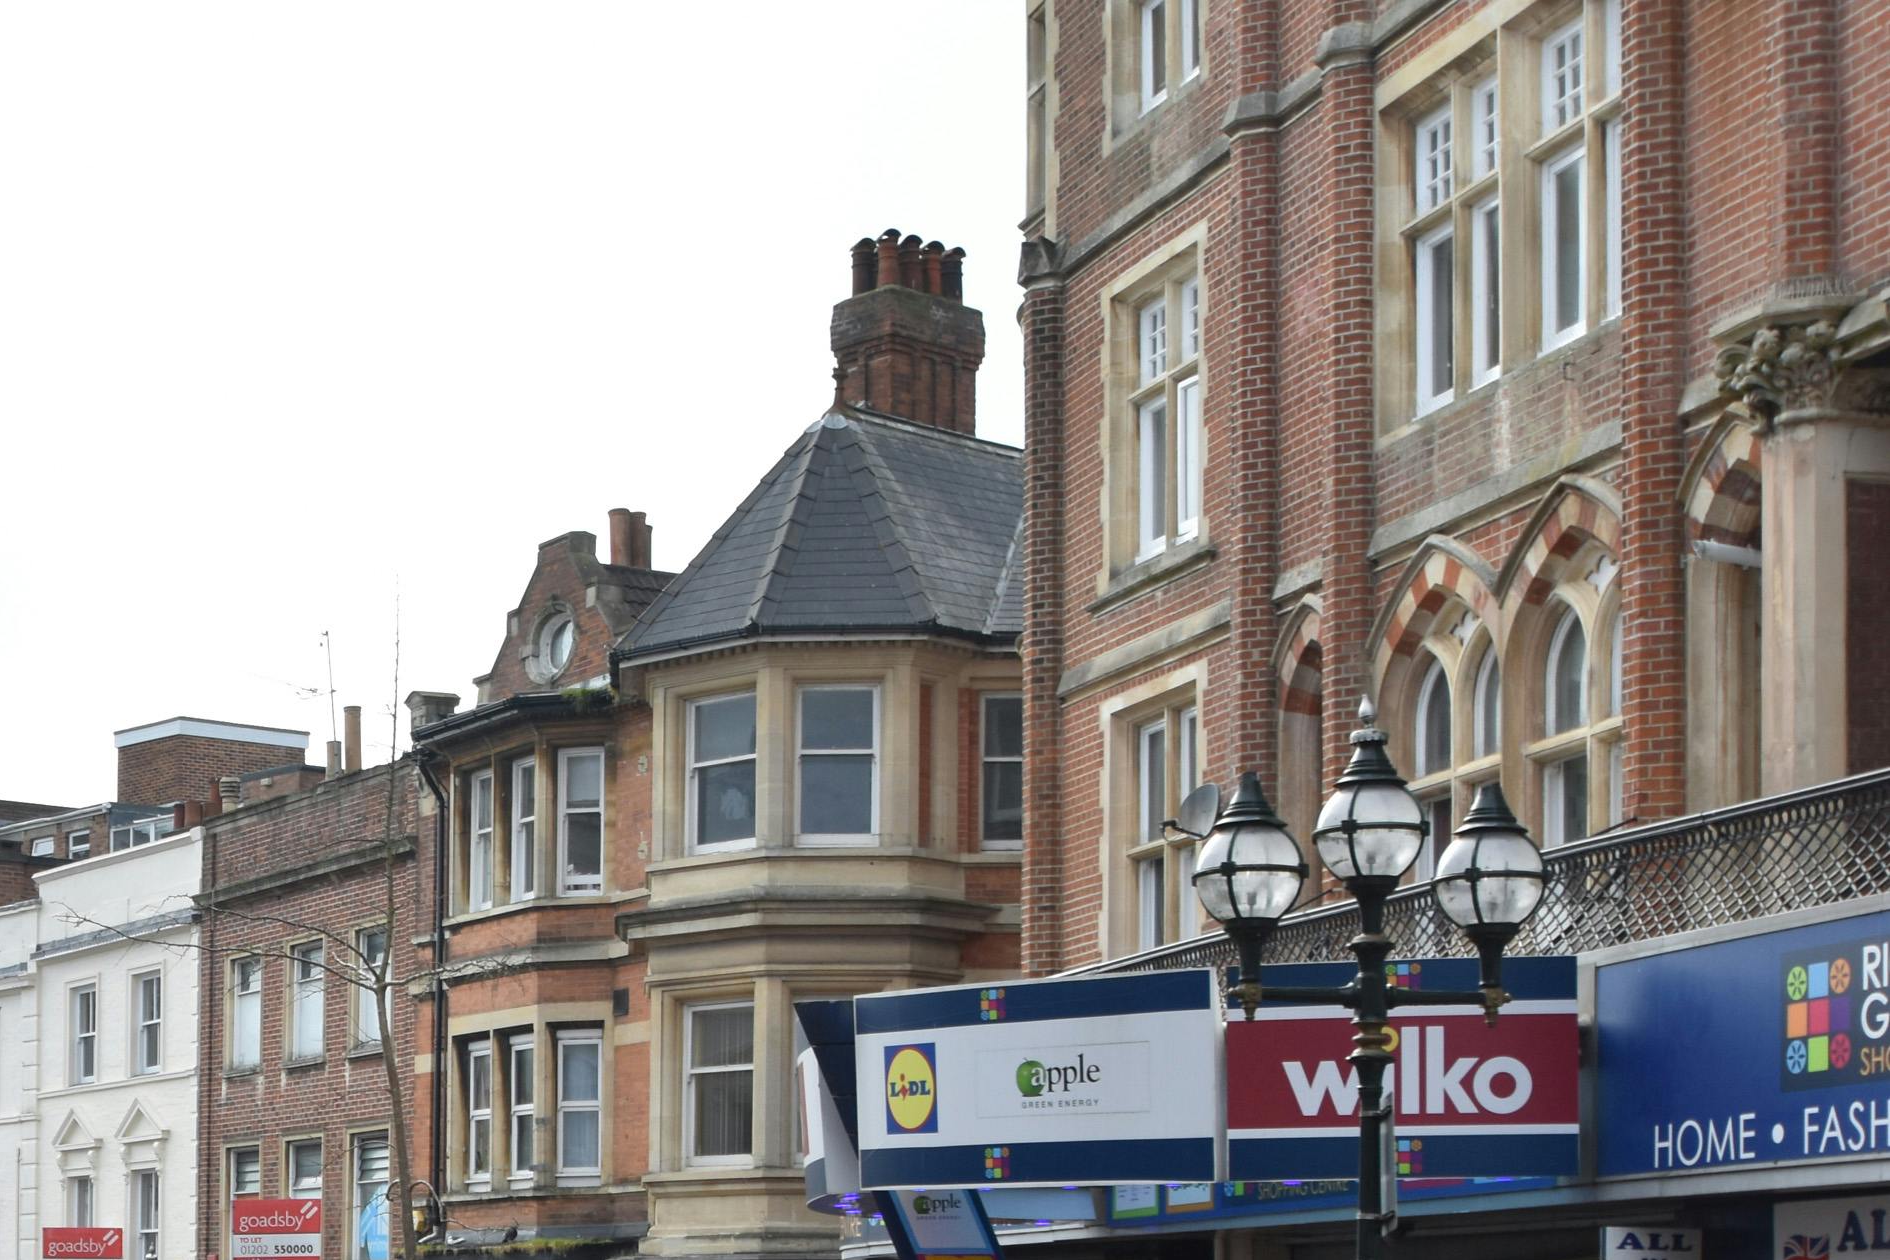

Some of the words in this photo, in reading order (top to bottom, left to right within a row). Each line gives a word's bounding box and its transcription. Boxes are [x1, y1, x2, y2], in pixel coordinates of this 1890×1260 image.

[1030, 1053, 1101, 1093] apple
[1282, 1025, 1533, 1117] wilko
[1021, 1101, 1054, 1109] GREEN
[1058, 1099, 1100, 1108] ENERGY
[1654, 1112, 1756, 1169] HOME
[238, 1210, 305, 1232] goadsby
[47, 1237, 108, 1257] goadsby
[239, 1244, 270, 1255] 01202
[273, 1244, 314, 1255] 550000
[1615, 1231, 1692, 1251] ALL
